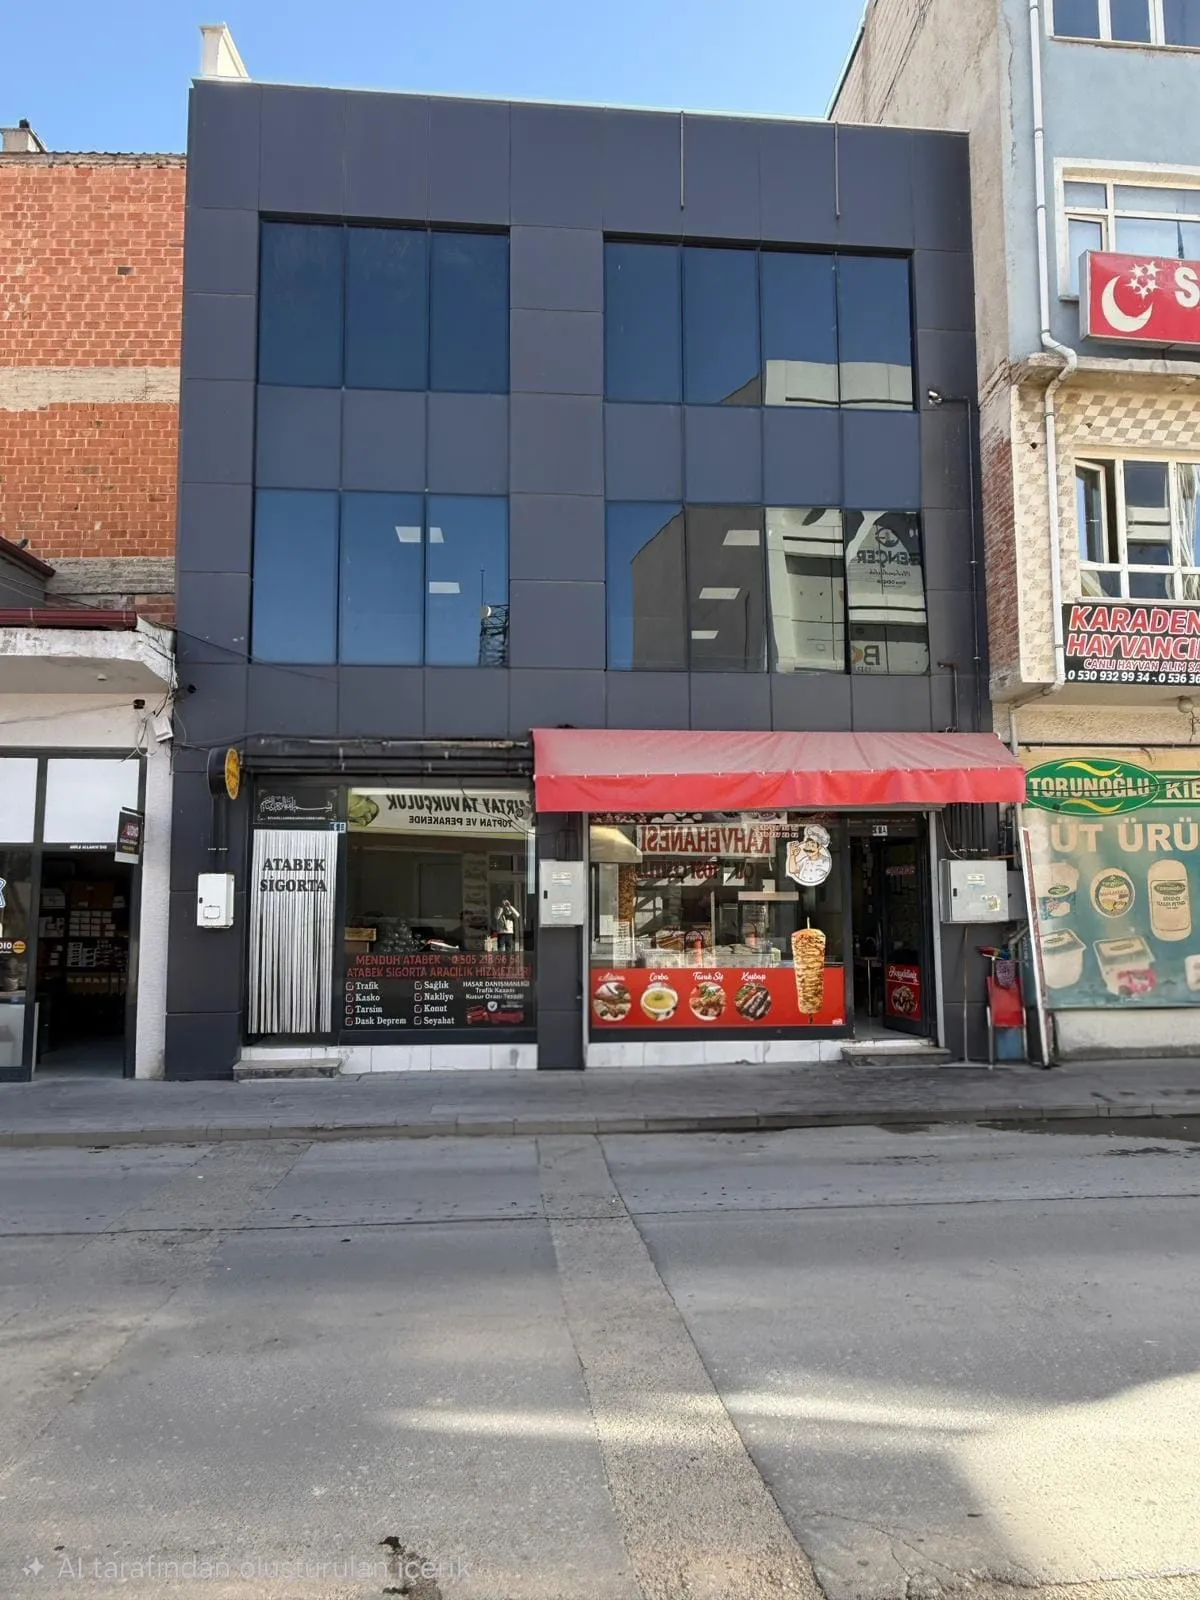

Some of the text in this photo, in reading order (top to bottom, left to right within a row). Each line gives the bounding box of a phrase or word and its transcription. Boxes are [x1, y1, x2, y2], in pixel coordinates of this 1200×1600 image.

[1084, 658, 1116, 670] CANLI
[1117, 660, 1159, 672] HAYVAN
[1160, 661, 1186, 673] ALIM
[1067, 670, 1076, 680] 0
[1077, 670, 1097, 680] 530
[1100, 671, 1119, 681] 932
[1120, 671, 1135, 682] 99
[1135, 672, 1150, 683] 34
[1158, 673, 1166, 683] 0
[1167, 673, 1187, 684] 536
[1029, 772, 1150, 797] TORUNOĞLU
[262, 858, 326, 872] ATABEK
[260, 875, 327, 892] SİGORTA
[403, 955, 441, 965] ATABEK
[347, 967, 385, 978] ATABEK
[355, 981, 379, 990] Trafik
[423, 980, 449, 991] Sağlık
[355, 993, 381, 1001] Kasko
[423, 993, 454, 1002] Nakliye
[355, 1004, 383, 1013] Tarsim
[423, 1004, 448, 1012] Konut
[355, 1016, 407, 1027] Dask Deprem
[423, 1016, 455, 1027] Seyahat
